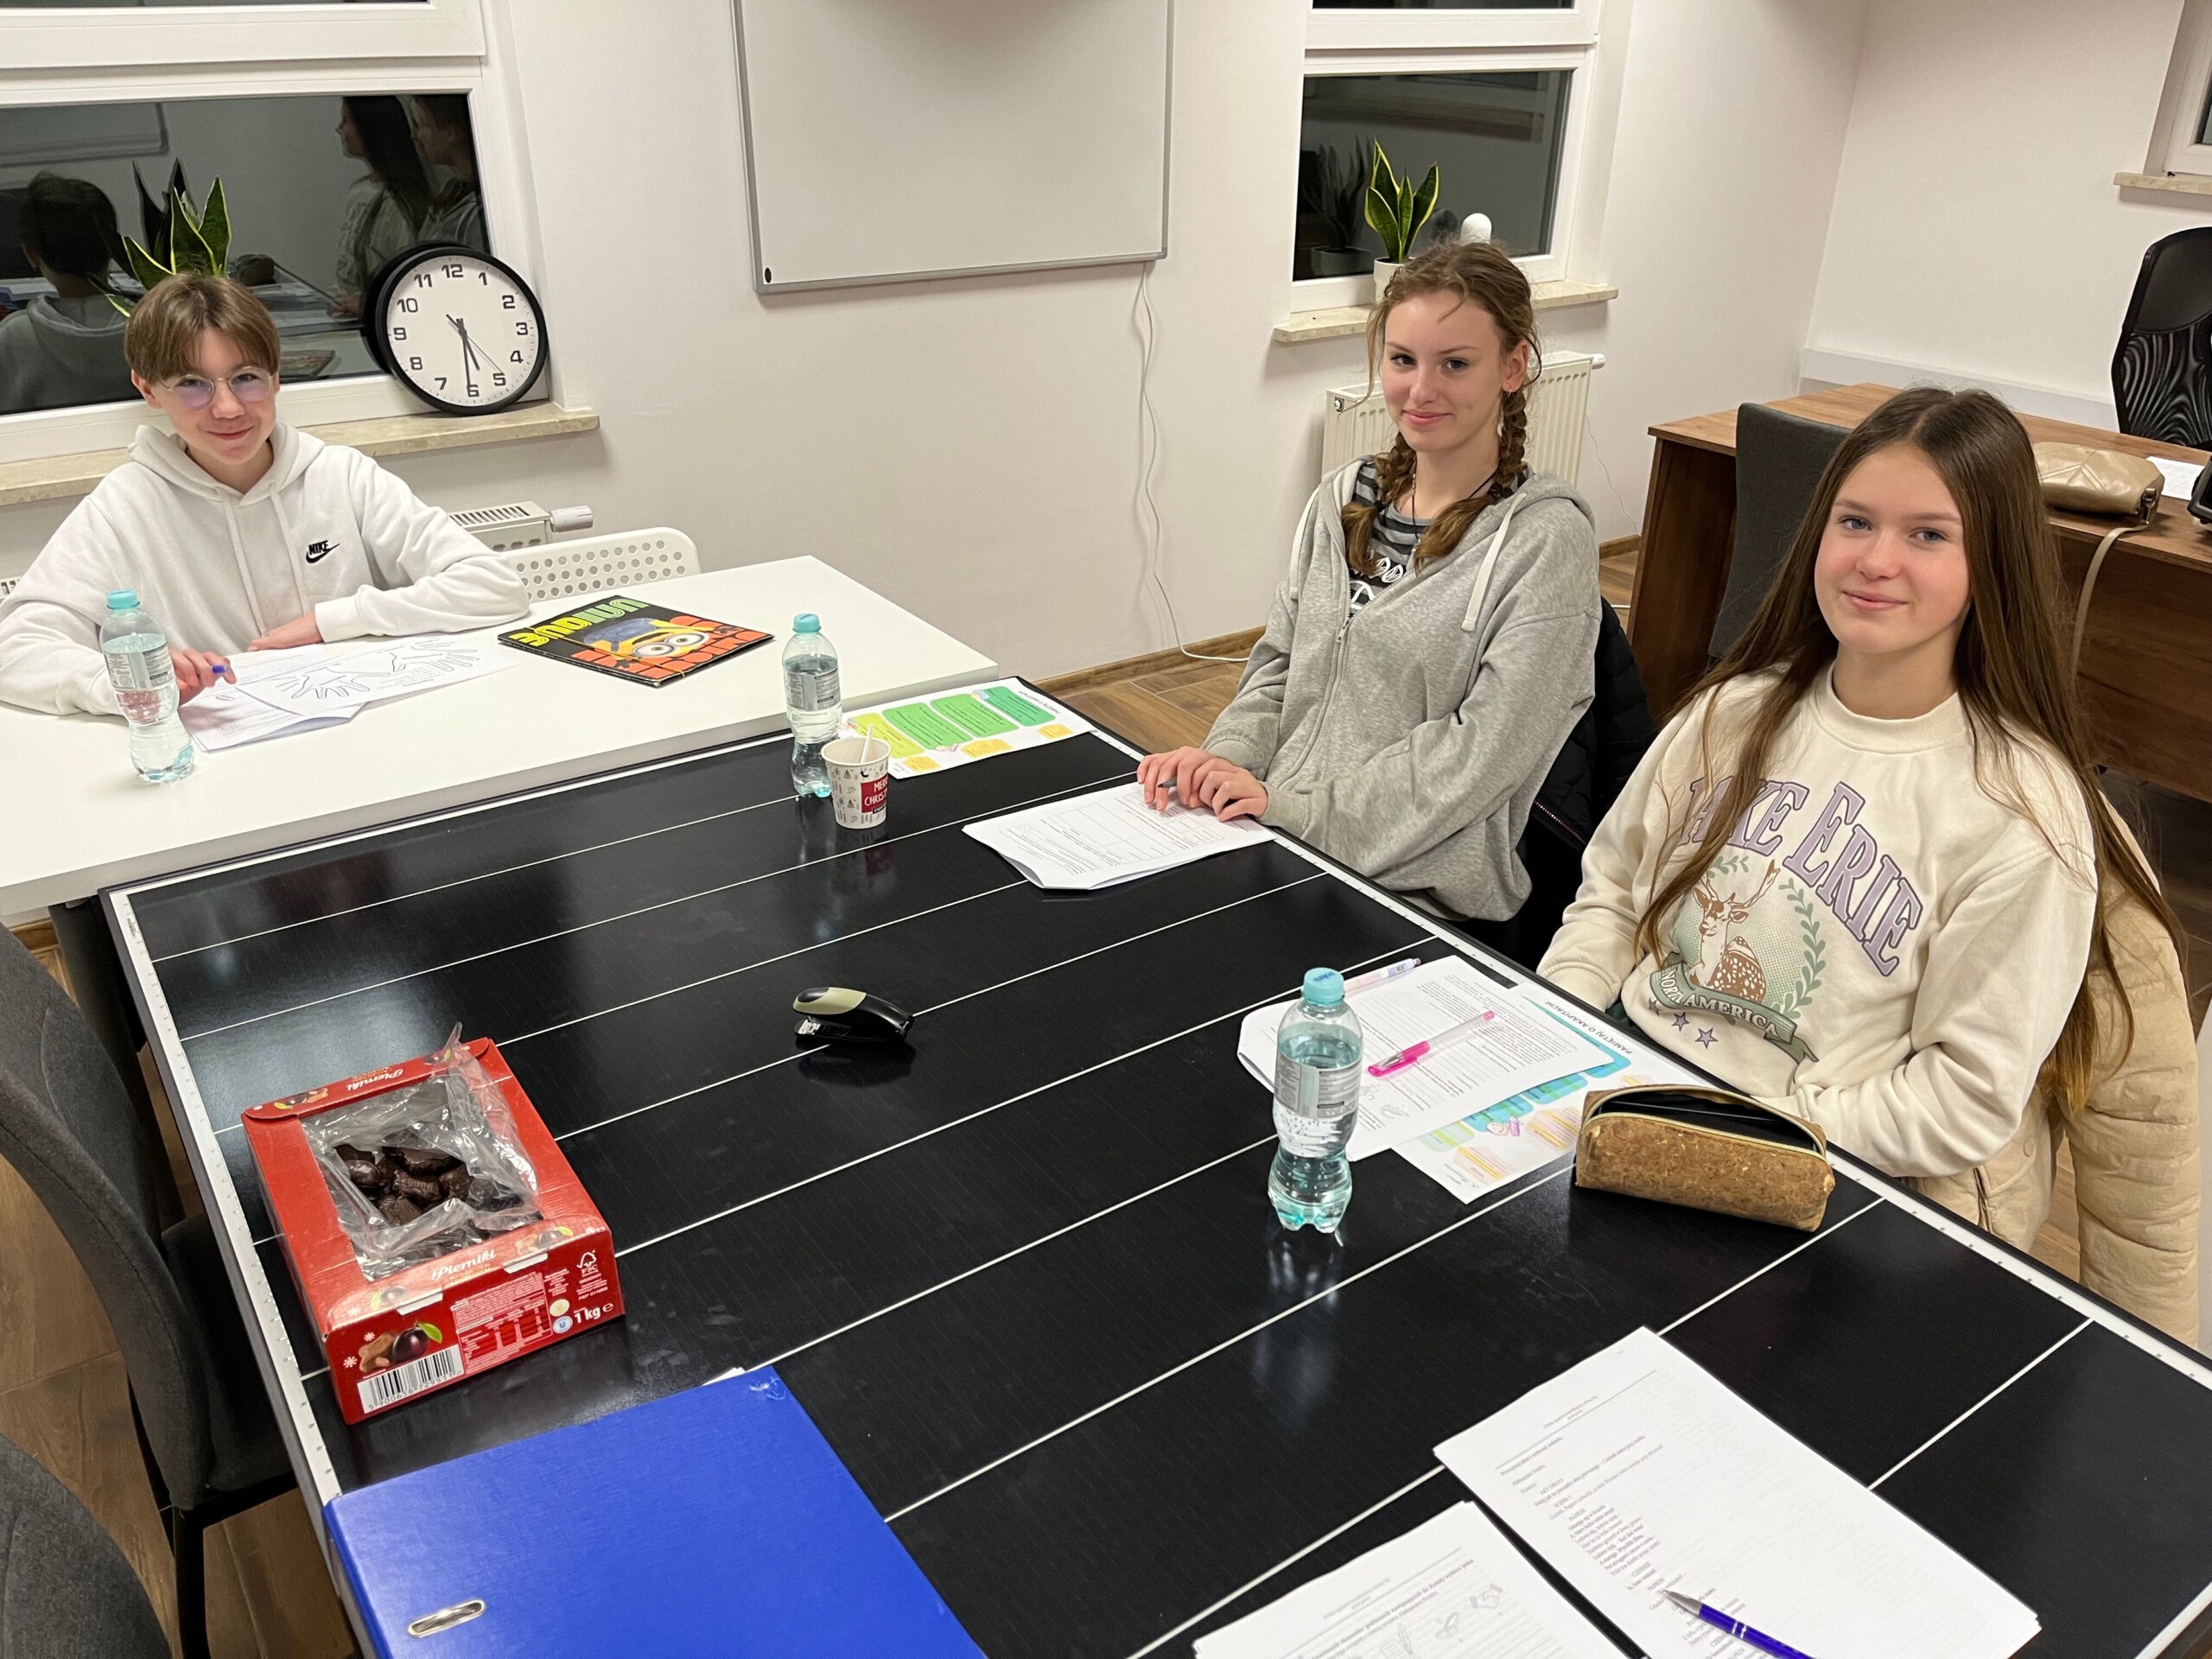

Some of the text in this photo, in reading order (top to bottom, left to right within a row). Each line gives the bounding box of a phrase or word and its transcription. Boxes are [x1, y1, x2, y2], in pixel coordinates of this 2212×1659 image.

[442, 264, 463, 278] 12
[414, 274, 432, 288] 11
[479, 272, 487, 285] 1
[397, 298, 418, 313] 10
[502, 295, 515, 309] 2
[393, 327, 407, 340] 9
[516, 322, 528, 335] 3
[410, 357, 423, 370] 8
[510, 351, 524, 363] 4
[435, 378, 447, 390] 7
[493, 372, 506, 386] 5
[467, 385, 480, 397] 6
[308, 540, 329, 556] NIKE
[508, 598, 649, 647] UNIQUE
[874, 775, 888, 793] MER
[1783, 781, 1923, 977] ERIE
[1684, 994, 1781, 1038] AMERICA
[346, 1069, 403, 1090] Pierniki
[431, 1249, 497, 1281] Pierniki
[575, 1312, 582, 1324] 1
[584, 1307, 601, 1320] kg
